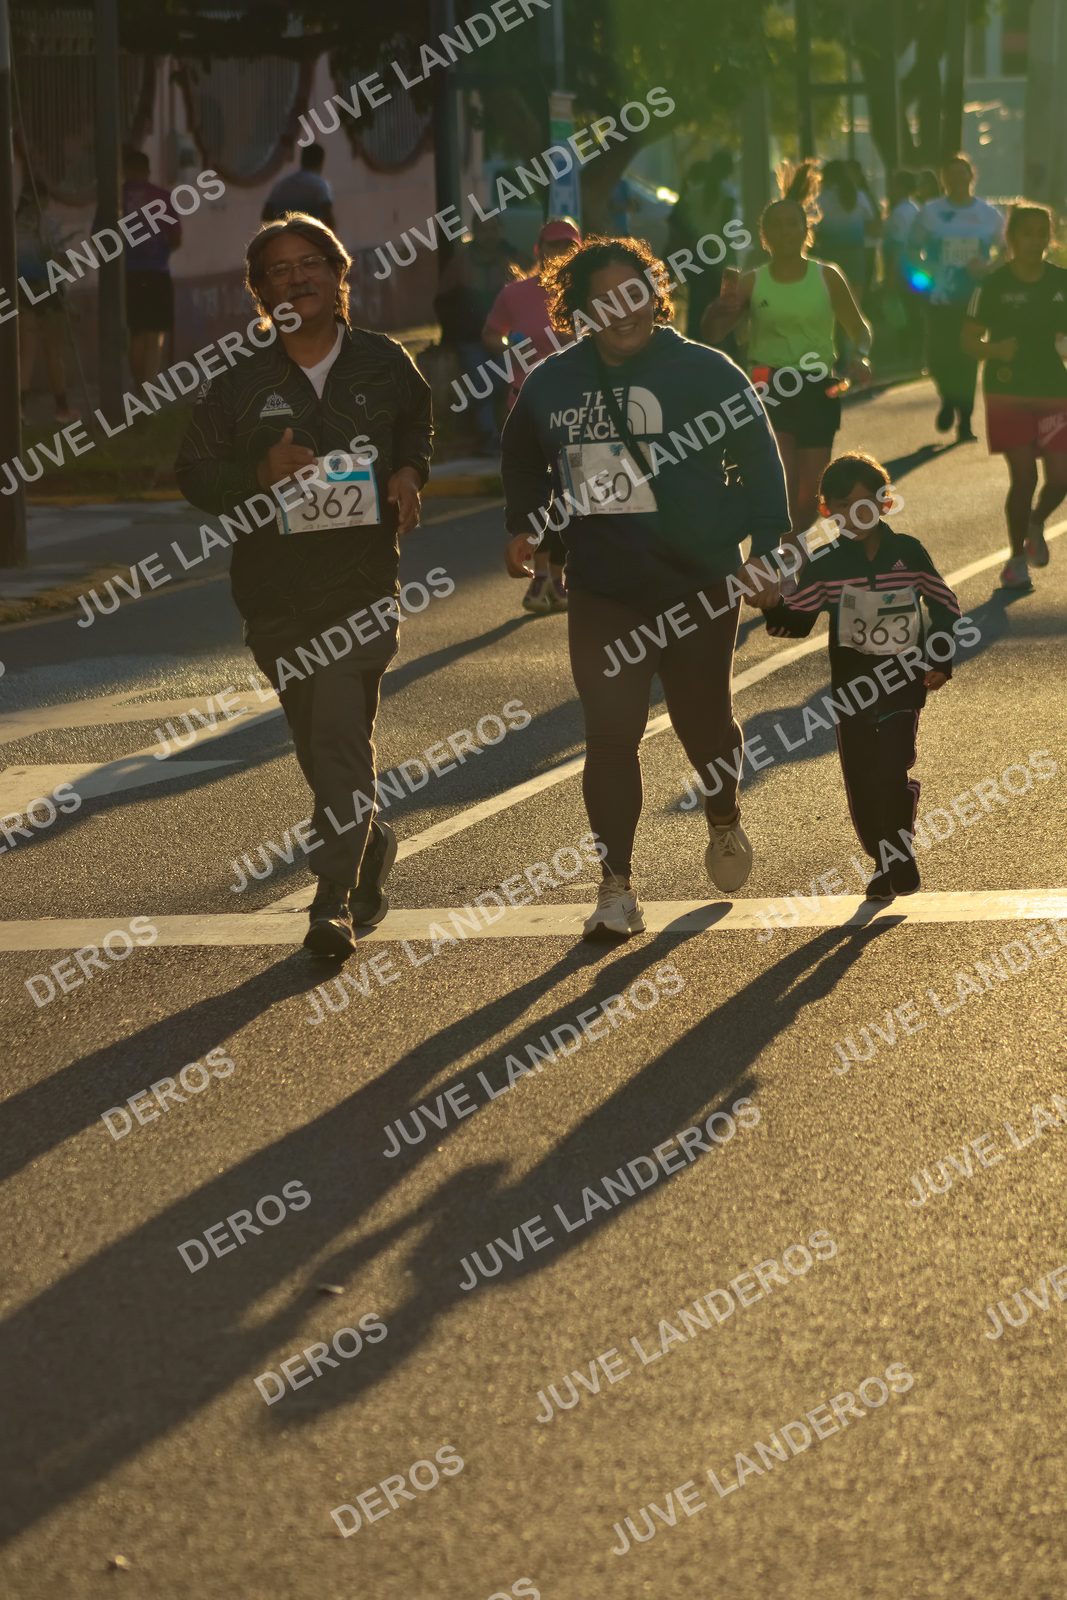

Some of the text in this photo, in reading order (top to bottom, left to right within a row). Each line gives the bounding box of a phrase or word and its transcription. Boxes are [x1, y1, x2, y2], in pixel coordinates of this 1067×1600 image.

[550, 405, 616, 429] NORT
[302, 485, 363, 521] 362
[851, 615, 910, 646] 363
